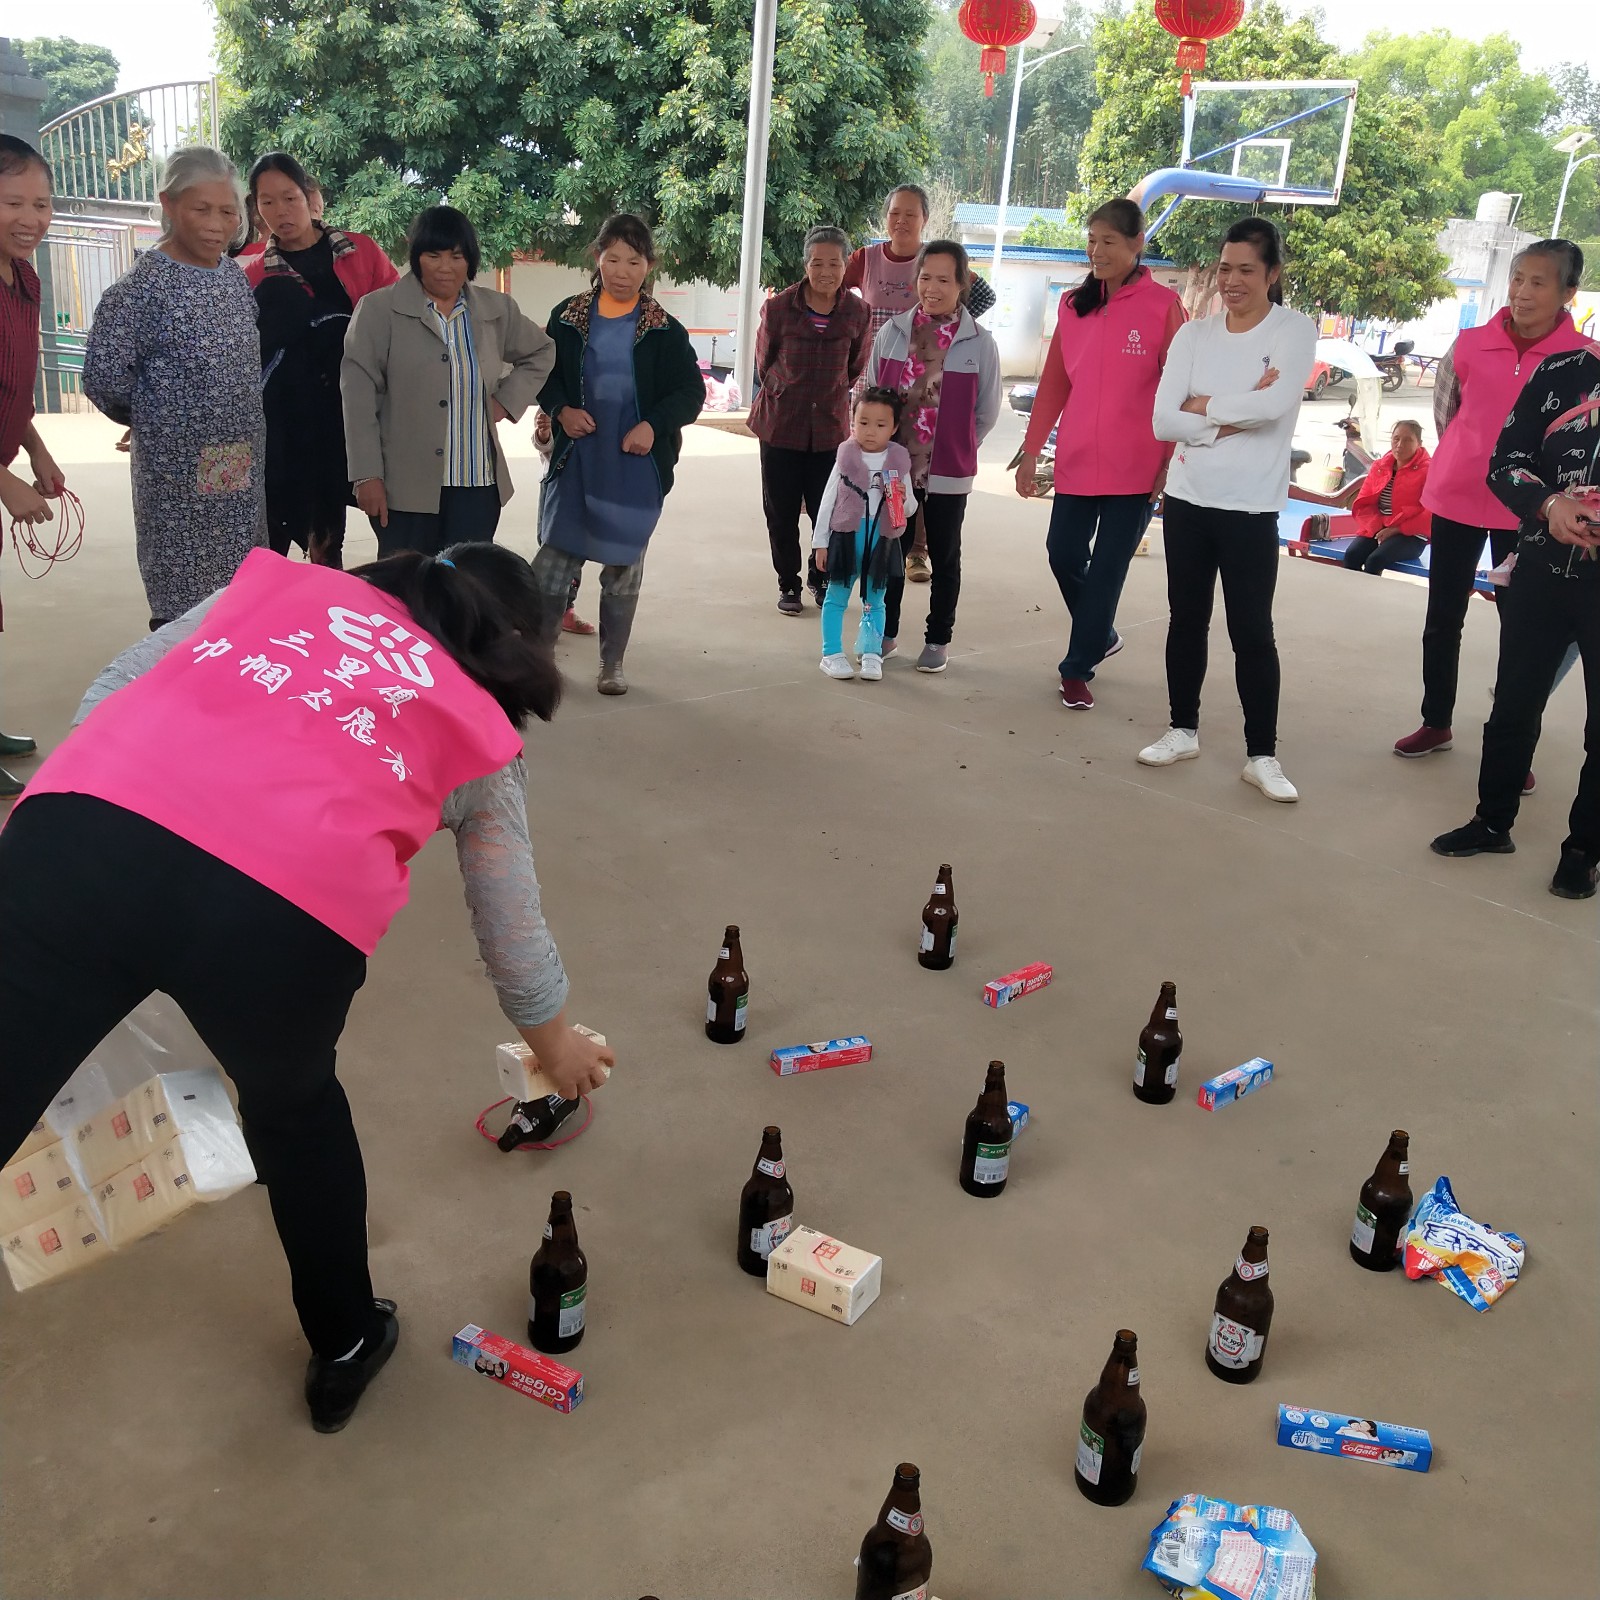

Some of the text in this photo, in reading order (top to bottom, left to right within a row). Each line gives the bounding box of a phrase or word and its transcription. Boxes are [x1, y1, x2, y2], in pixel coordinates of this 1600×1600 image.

[193, 638, 412, 782] 巾帼志愿者
[511, 1370, 566, 1402] Colgate
[1342, 1444, 1378, 1456] Colgate
